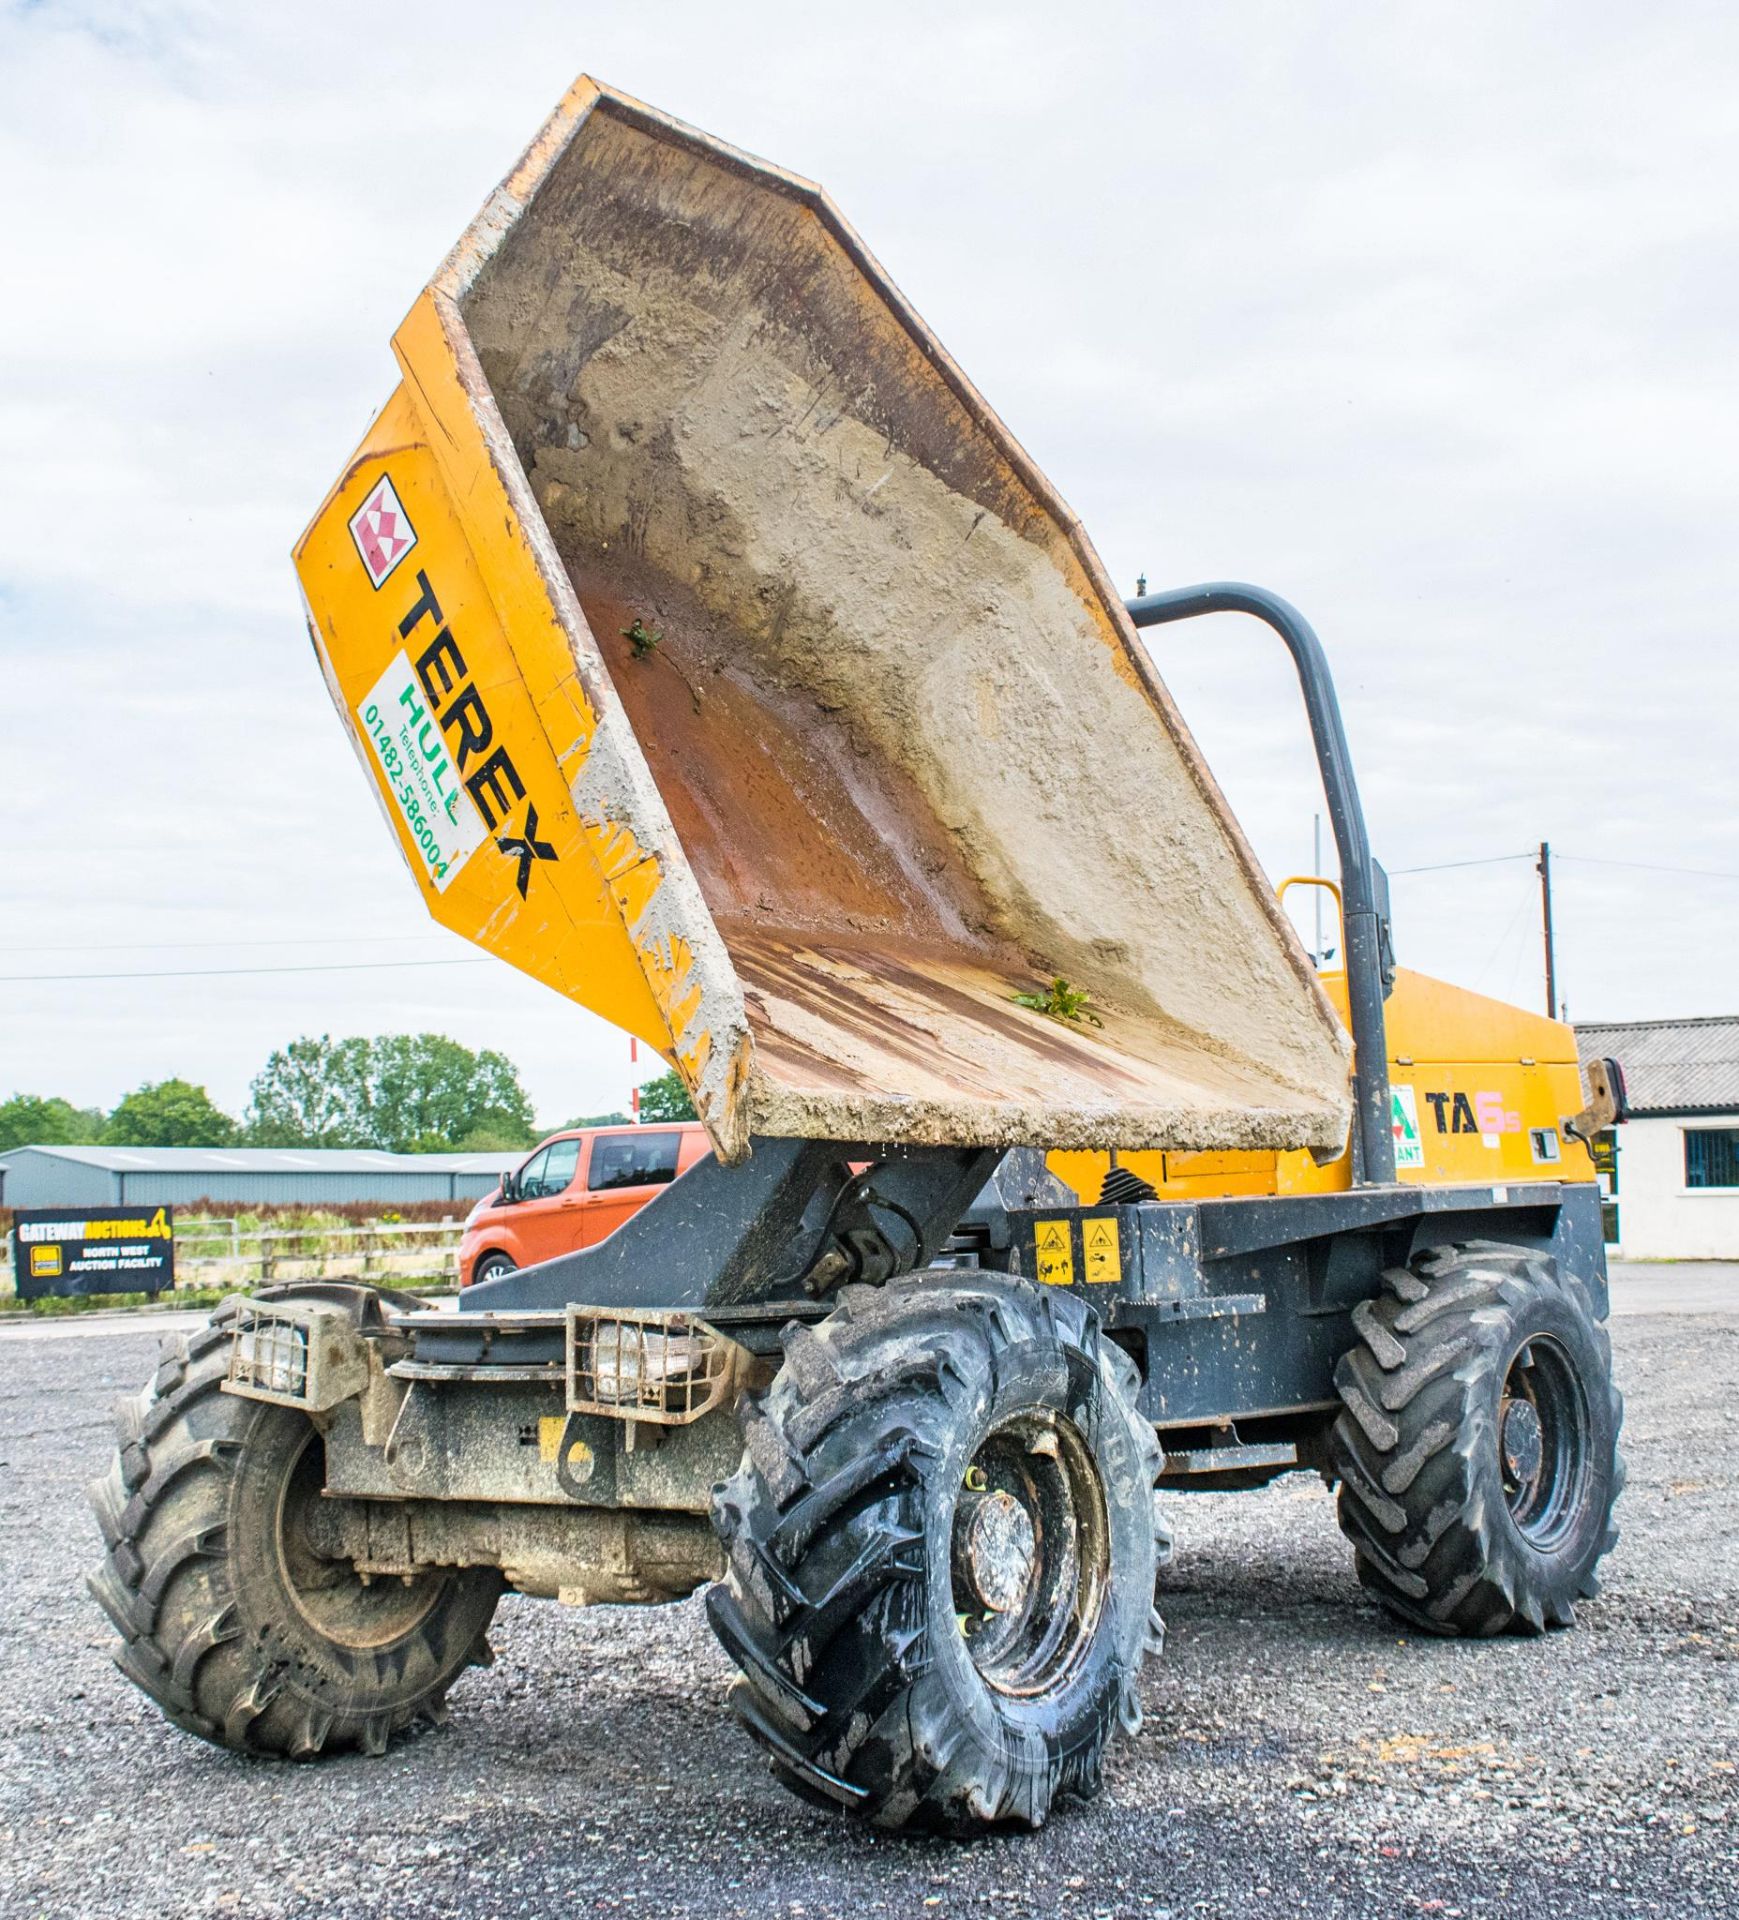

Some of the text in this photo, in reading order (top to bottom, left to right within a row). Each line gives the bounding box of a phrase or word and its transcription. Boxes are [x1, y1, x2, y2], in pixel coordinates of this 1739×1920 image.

[364, 704, 449, 880] 01482-586004
[398, 568, 559, 902] TEREX
[399, 682, 458, 826] HULL
[399, 723, 439, 817] Telephone:
[69, 1259, 116, 1271] AUCTION
[118, 1257, 163, 1269] FACILITY
[82, 1245, 150, 1258] NORTH WEST
